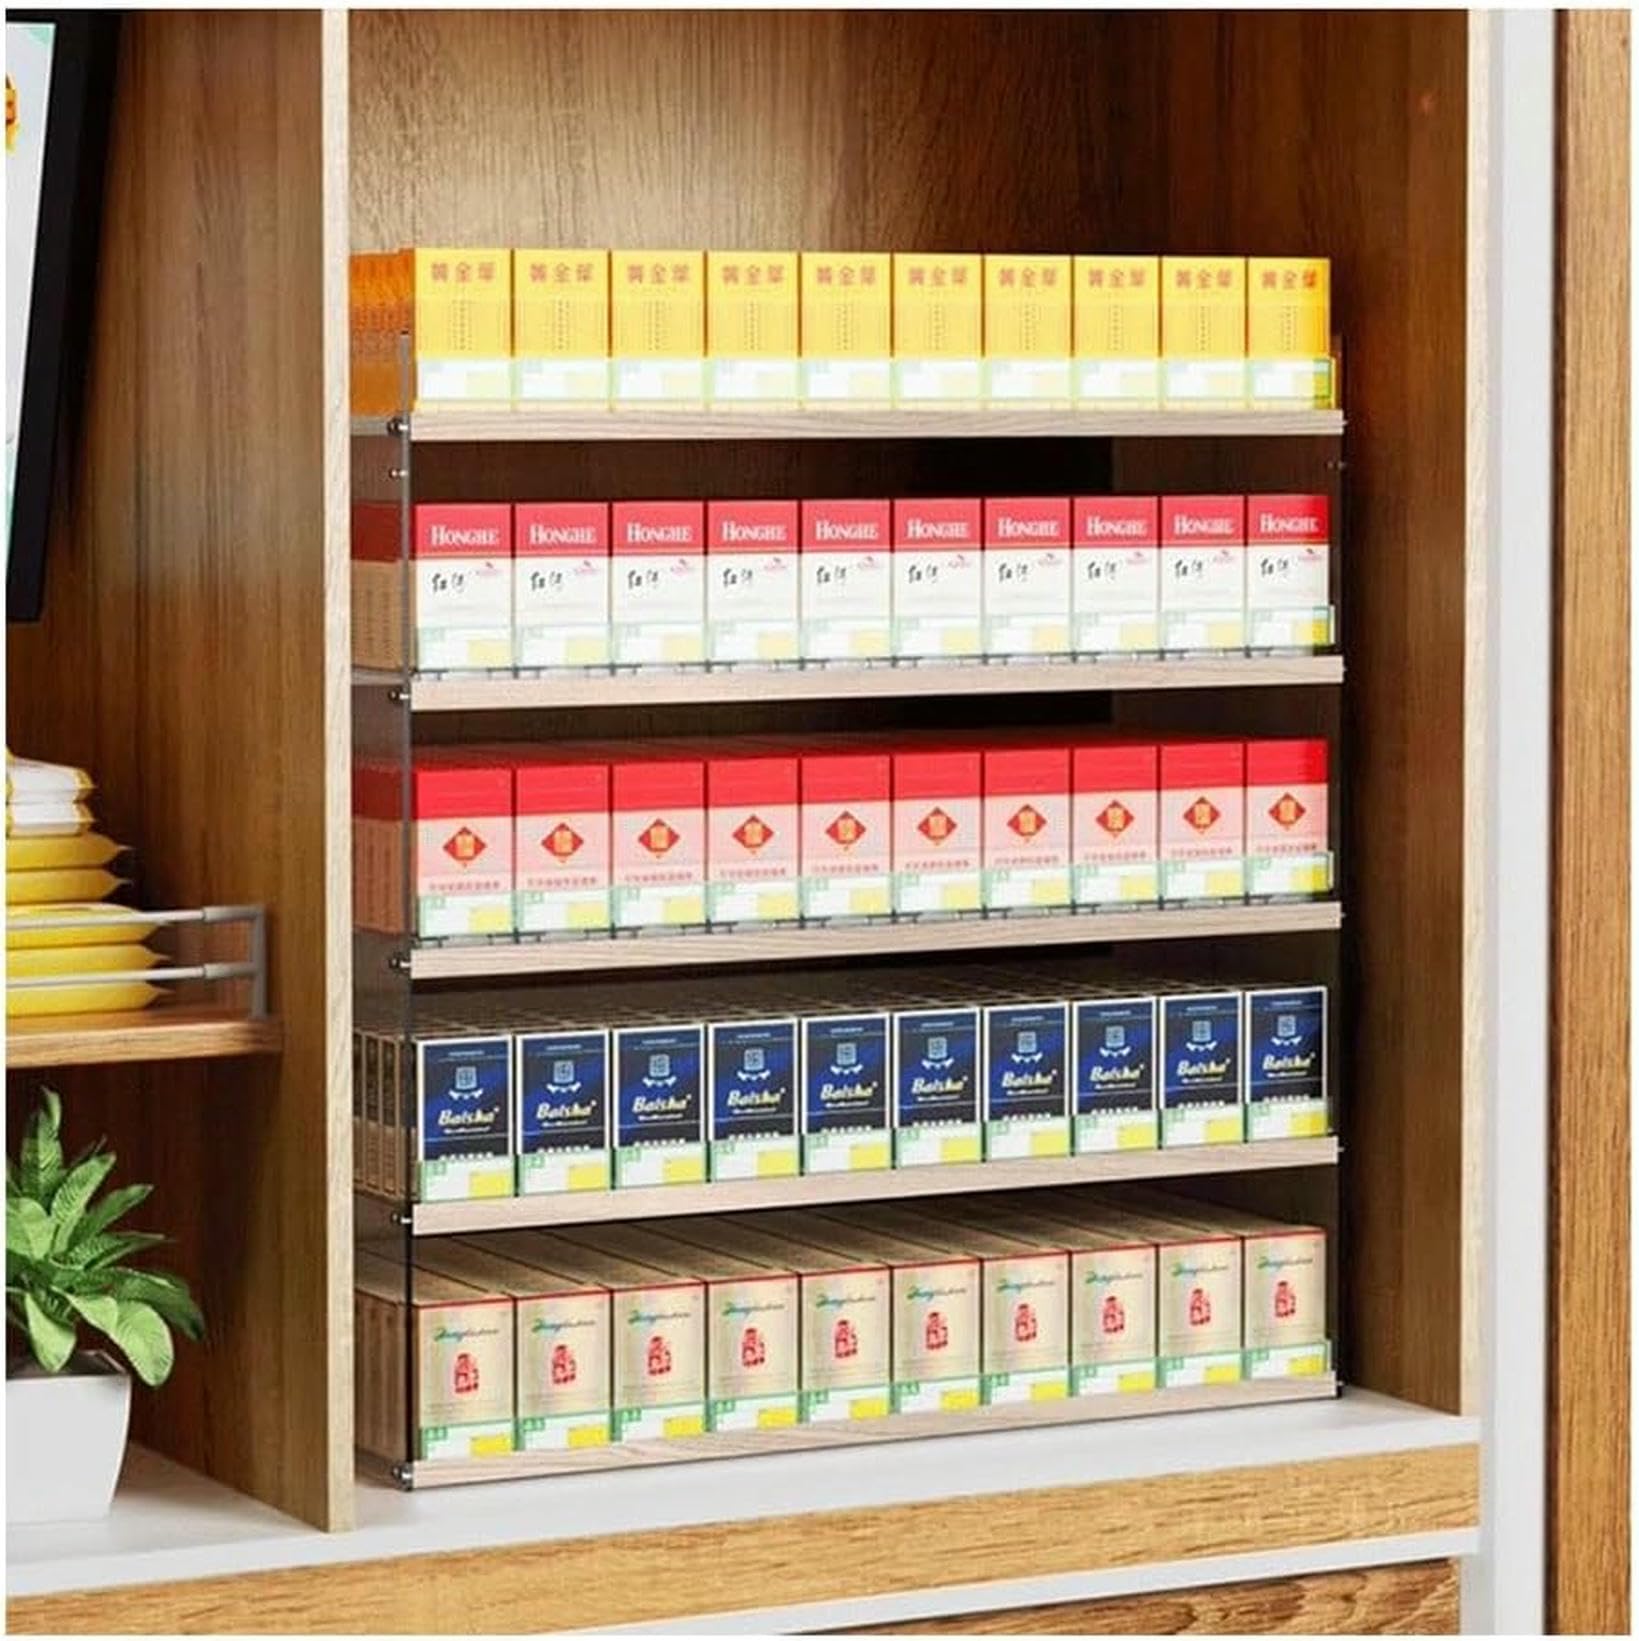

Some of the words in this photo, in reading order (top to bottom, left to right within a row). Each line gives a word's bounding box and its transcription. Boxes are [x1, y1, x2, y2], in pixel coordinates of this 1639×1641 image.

[626, 522, 692, 542] HONGHE
[722, 521, 786, 541] HONGHE
[815, 519, 879, 539] HONGHE
[907, 518, 970, 538] HONGHE
[998, 517, 1059, 537] HONGHE
[1087, 516, 1147, 535] HONGHE
[1174, 515, 1233, 534] HONGHE
[1259, 513, 1317, 533] HONGHE
[431, 525, 500, 546] HONGHE
[529, 523, 597, 544] HONGHE
